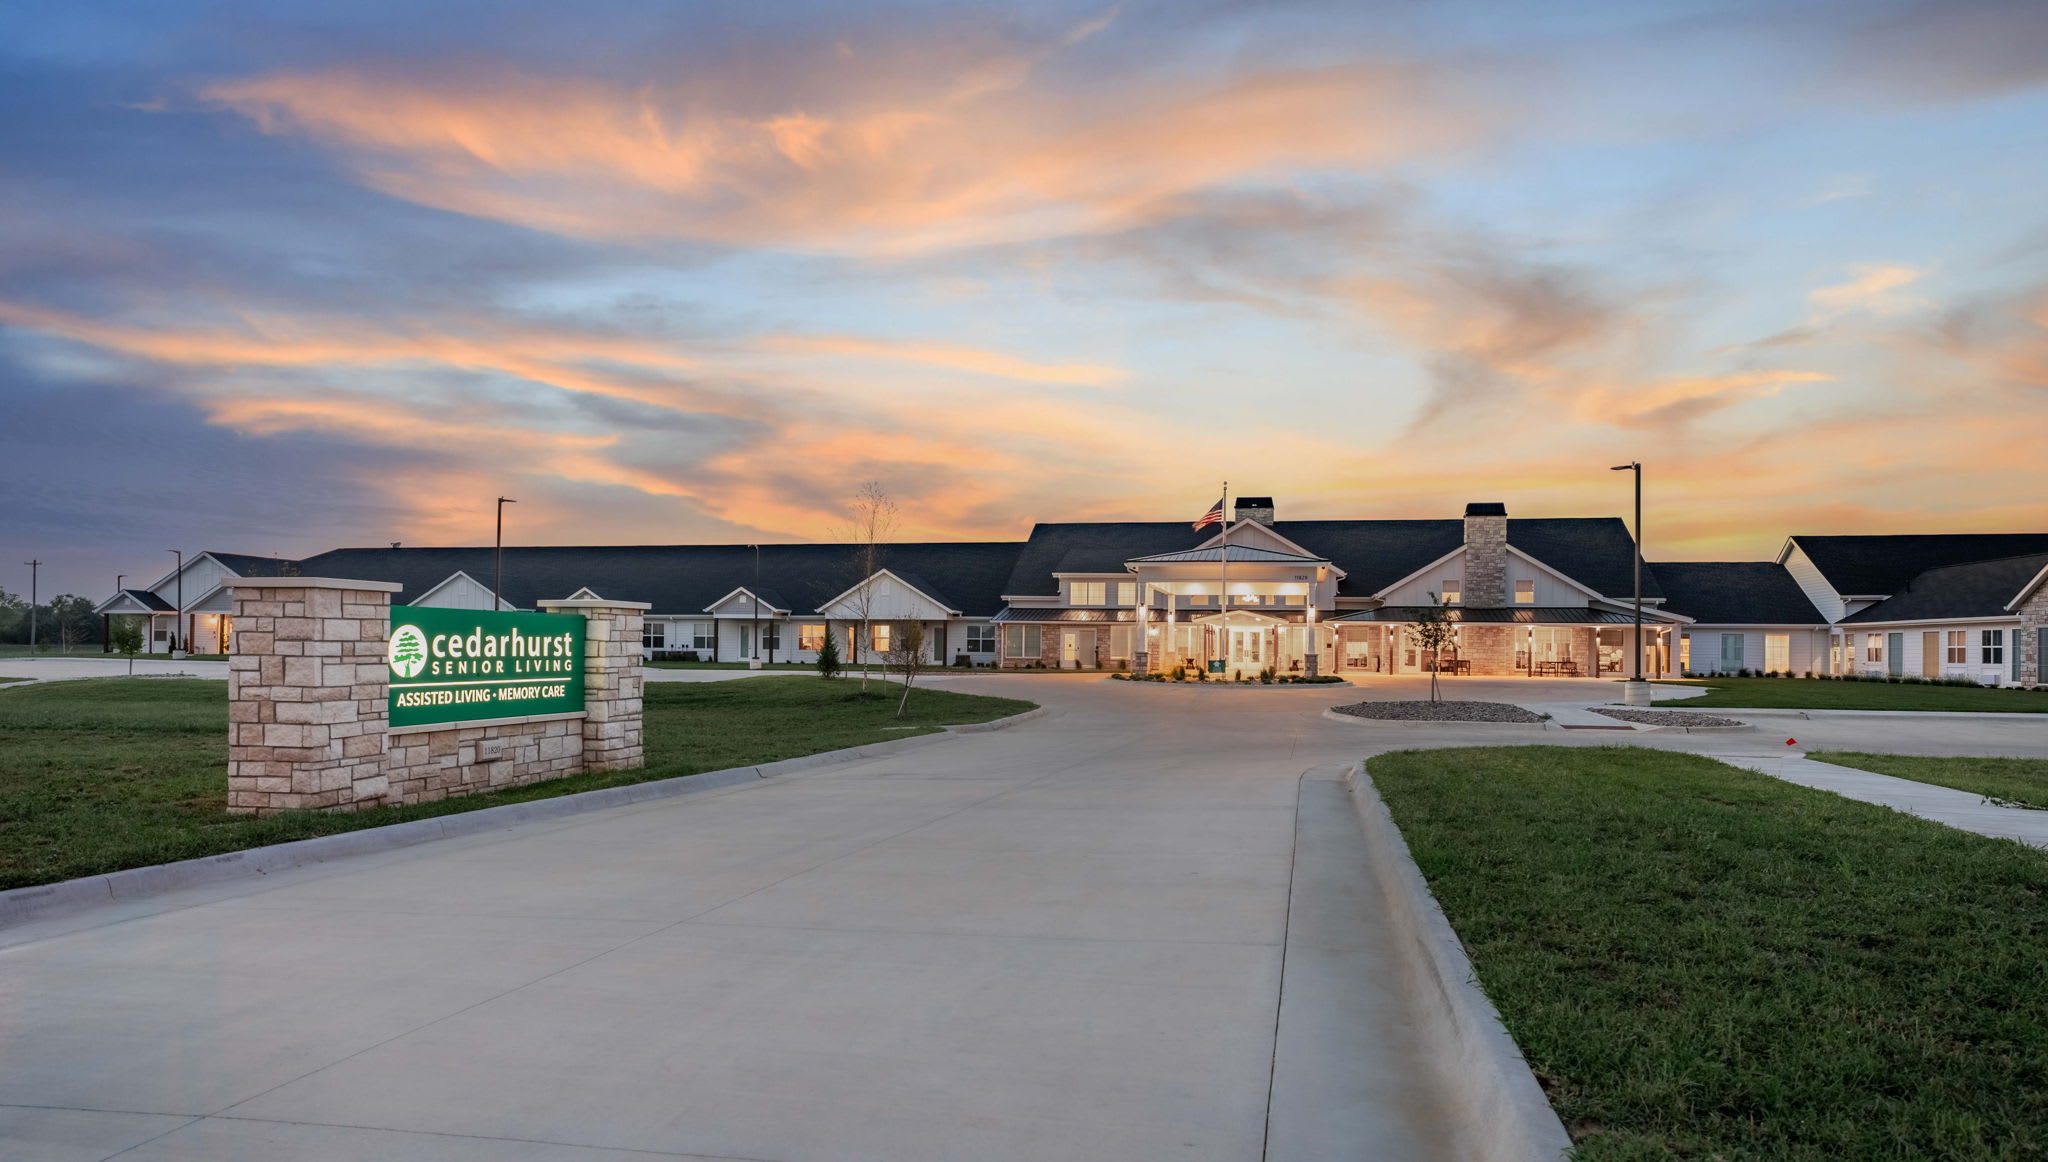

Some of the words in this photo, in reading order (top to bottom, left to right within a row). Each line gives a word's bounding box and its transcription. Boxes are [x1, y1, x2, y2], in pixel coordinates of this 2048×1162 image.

[432, 626, 573, 658] cedarhurst
[431, 660, 504, 675] SENIOR
[515, 659, 573, 673] LIVING
[397, 690, 453, 707] ASSISTED
[455, 688, 491, 703] LIVING
[498, 685, 541, 700] MEMORY
[541, 684, 566, 697] CARE
